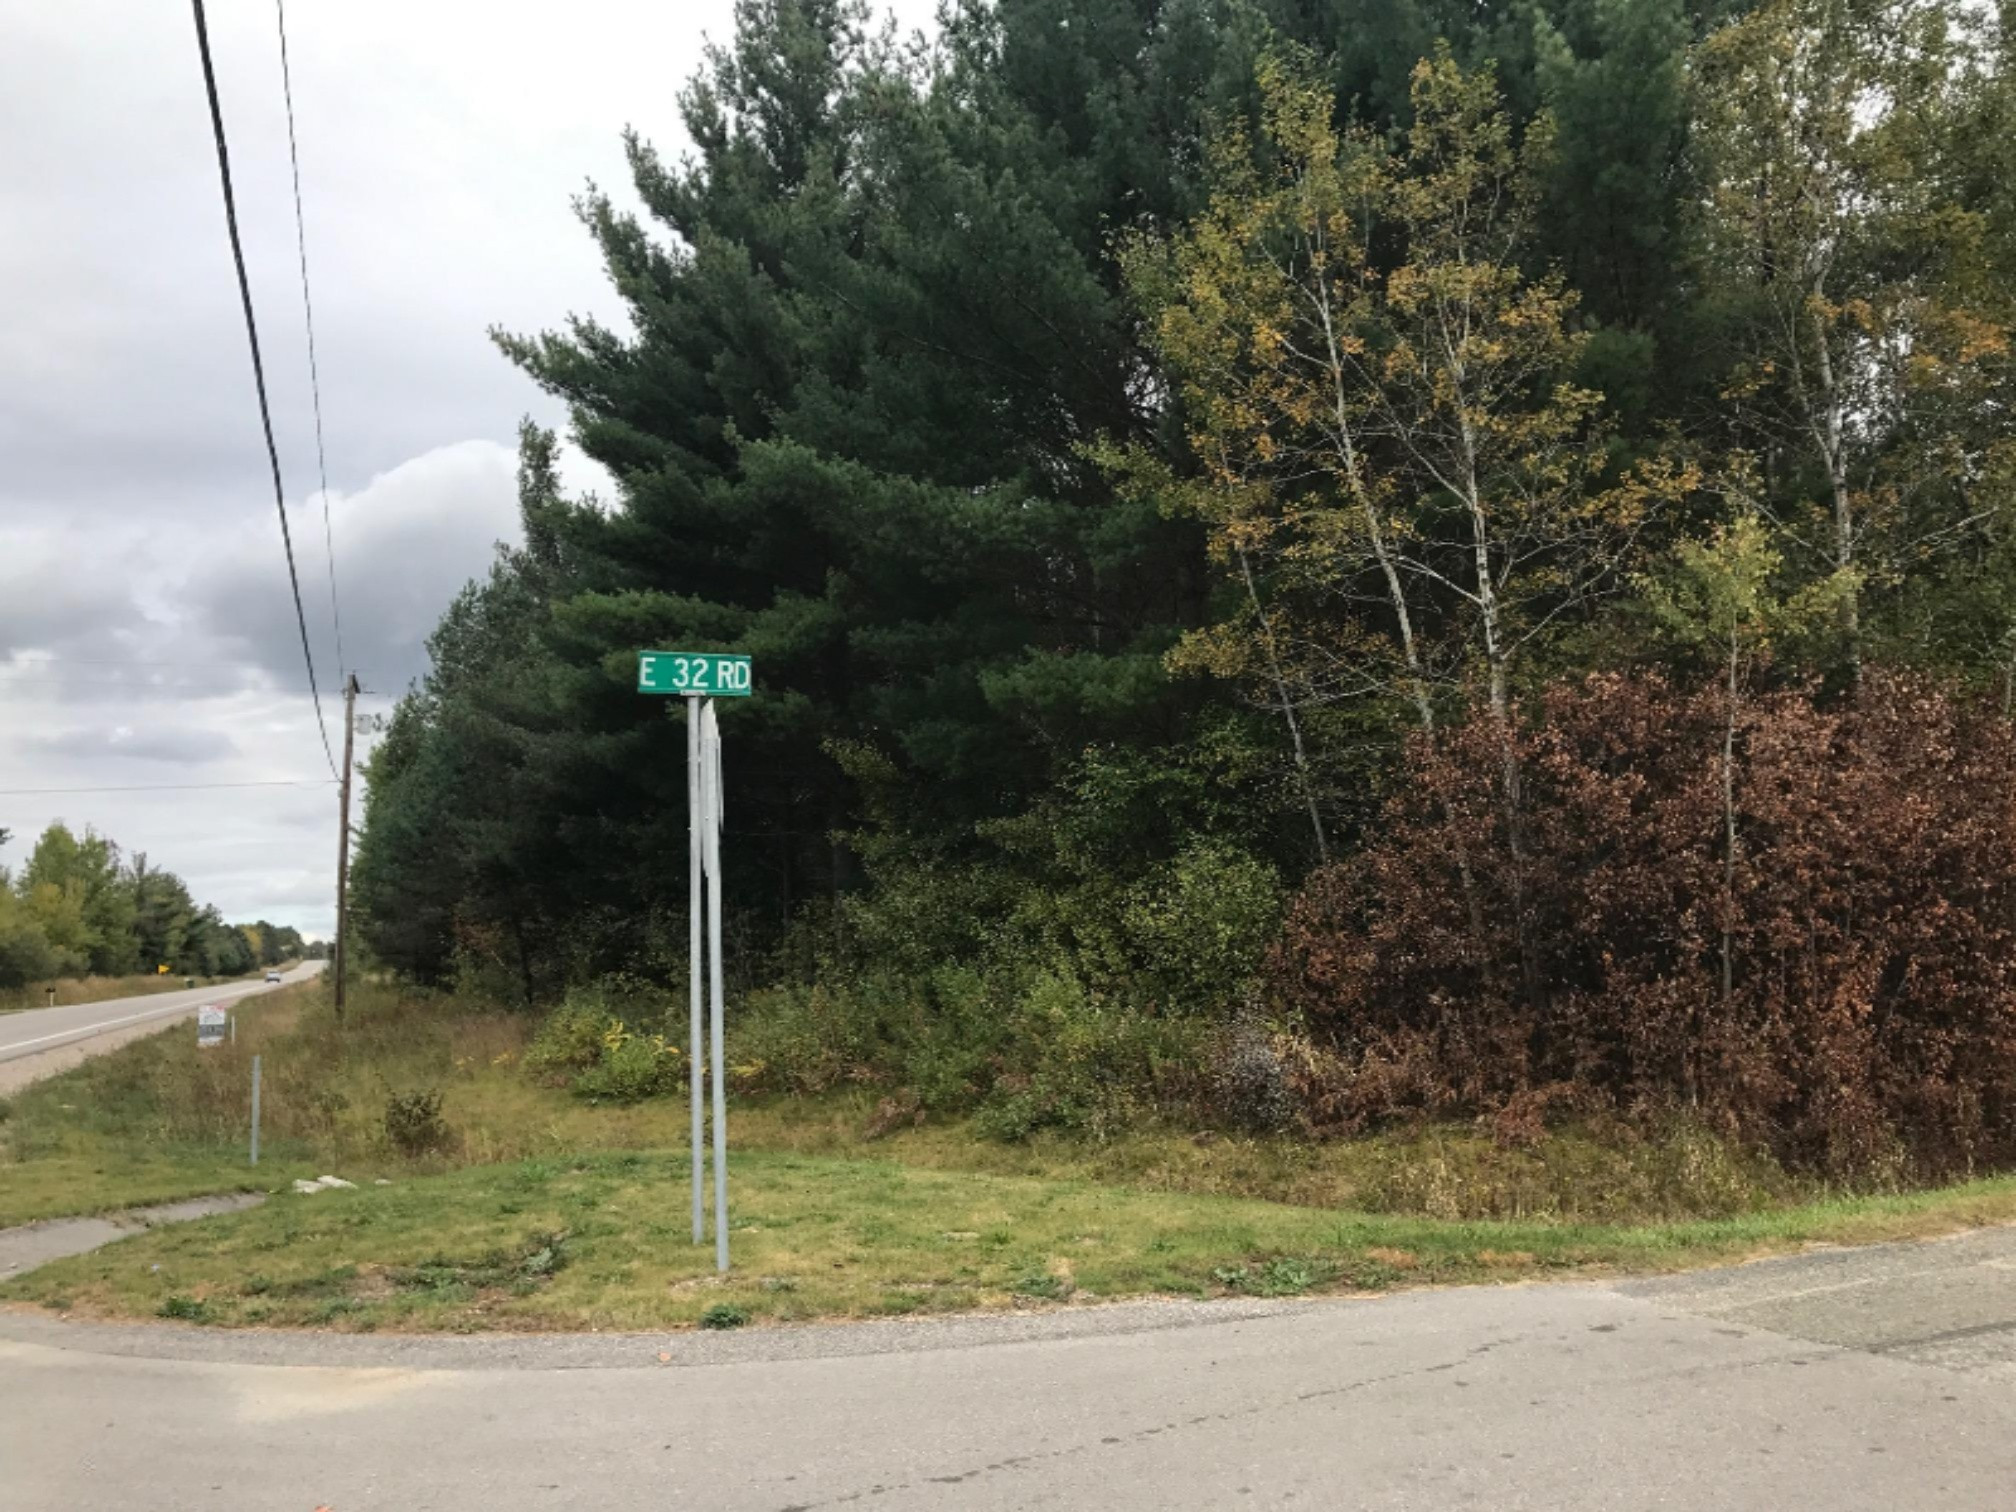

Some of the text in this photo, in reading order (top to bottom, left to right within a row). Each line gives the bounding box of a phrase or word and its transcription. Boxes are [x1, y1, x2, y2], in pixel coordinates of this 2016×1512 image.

[640, 657, 751, 689] E 32 RD
